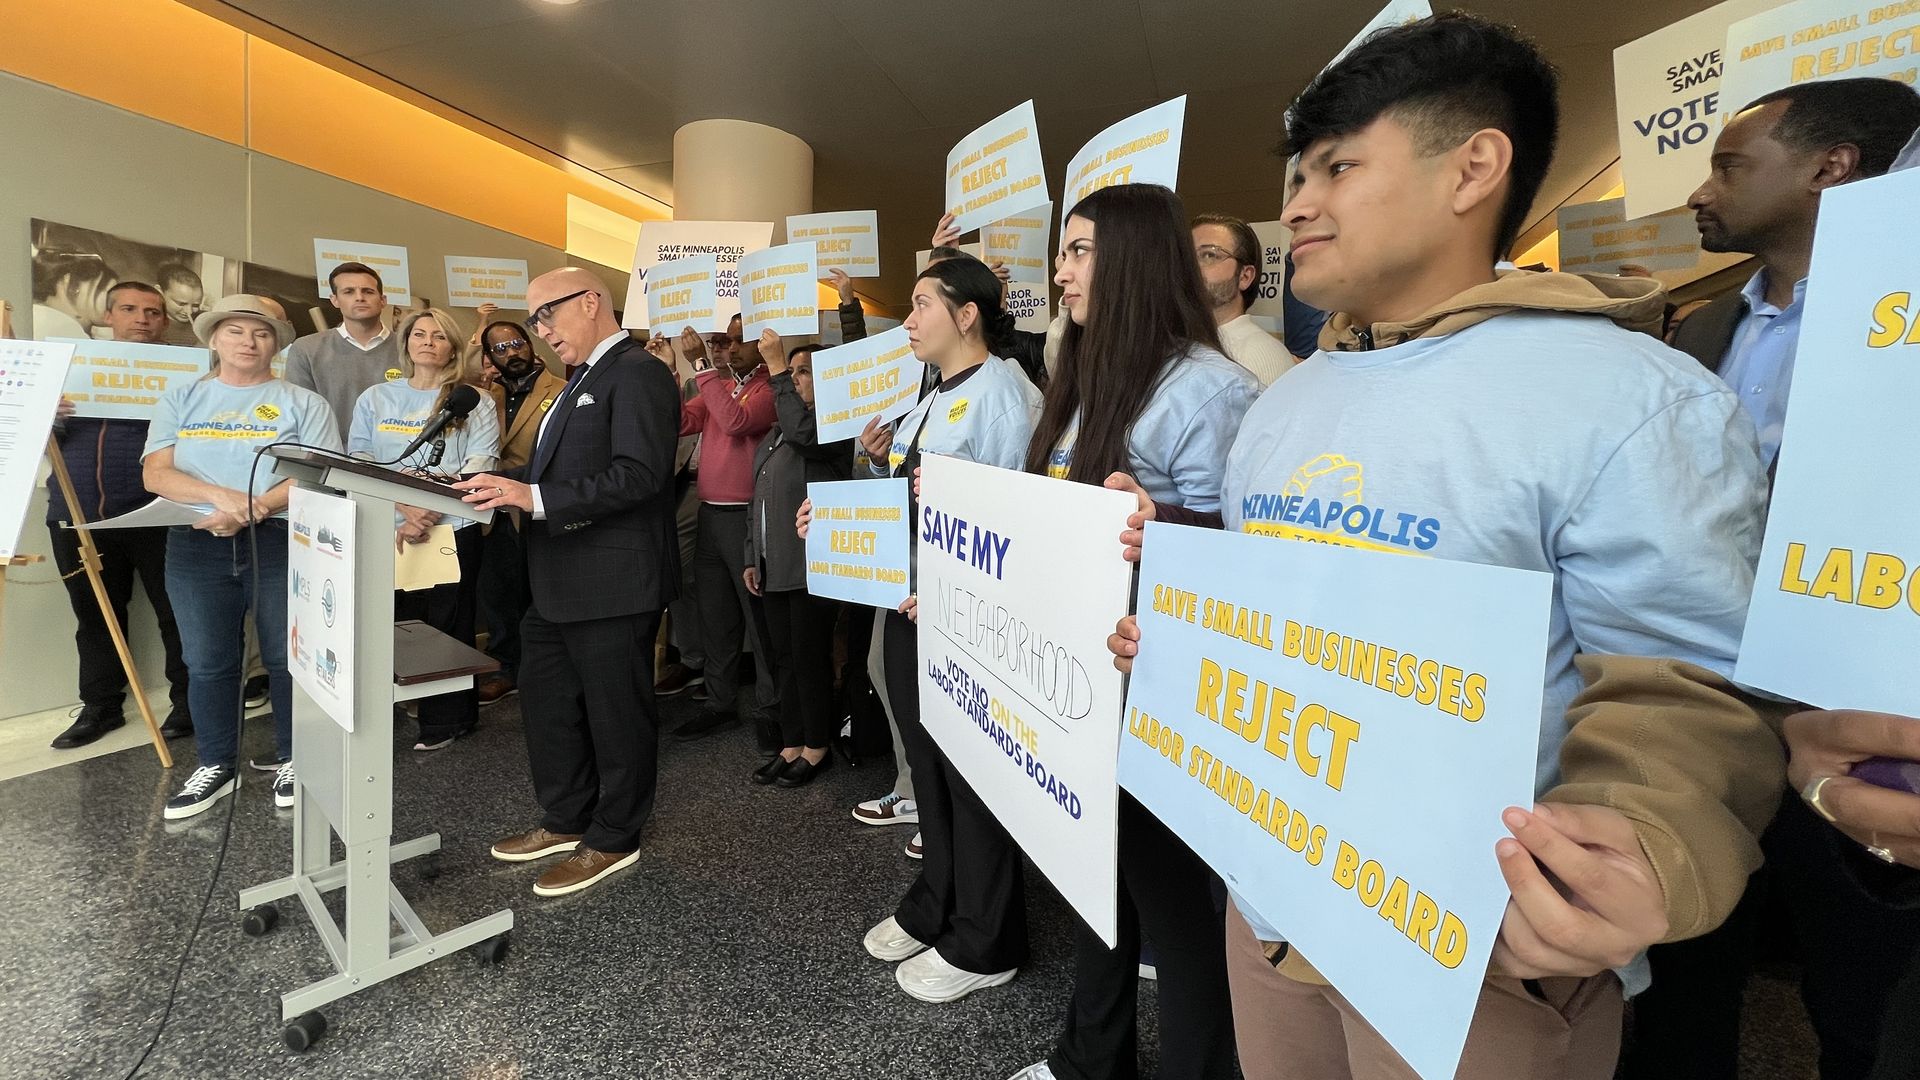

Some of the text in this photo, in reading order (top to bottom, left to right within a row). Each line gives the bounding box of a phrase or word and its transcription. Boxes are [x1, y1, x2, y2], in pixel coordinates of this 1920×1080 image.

[1740, 36, 1786, 61] SAVE
[1791, 14, 1860, 46] SMALL
[1666, 49, 1720, 80] SAVE
[1633, 91, 1719, 137] VOTE
[1657, 122, 1708, 155] NO
[962, 157, 1007, 194] REJECT
[657, 244, 745, 255] SAVE MINNEAPOLIS
[660, 288, 692, 309] REJECT
[752, 282, 786, 306] REJECT
[92, 371, 168, 391] REJECT
[849, 367, 900, 400] REJECT
[180, 421, 278, 432] MINNEAPOLIS
[1242, 493, 1441, 550] MINNEAPOLIS
[830, 529, 877, 555] REJECT
[922, 505, 1011, 581] SAVE MY
[876, 567, 907, 585] BOARD
[938, 576, 1093, 720] NEIGHBORHOOD
[1153, 584, 1488, 723] SAVE SMALL BUSINESSES
[946, 655, 1038, 755] VOTE NO ON THE
[928, 658, 1082, 821] LABOR STANDARDS BOARD
[1195, 657, 1361, 792] REJECT
[1129, 706, 1469, 970] LABOR STANDARDS BOARD
